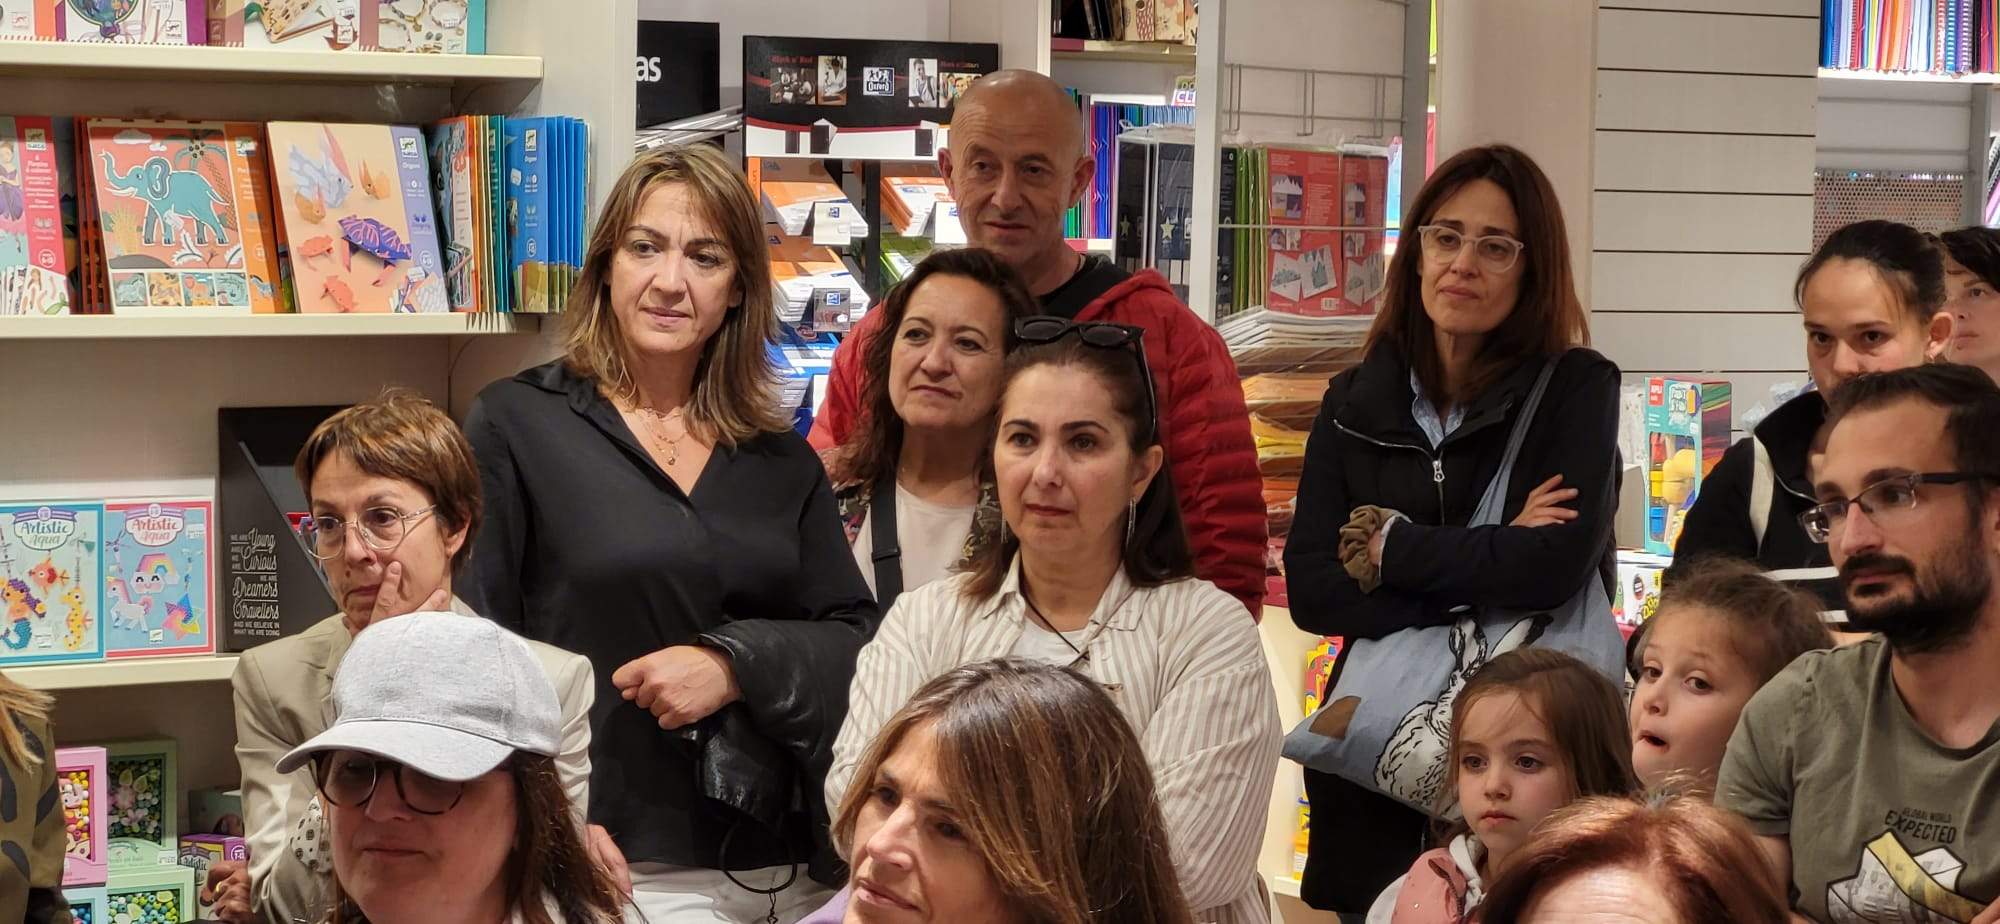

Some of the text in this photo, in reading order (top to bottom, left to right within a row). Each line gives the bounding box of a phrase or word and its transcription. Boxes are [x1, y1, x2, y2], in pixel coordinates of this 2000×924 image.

[867, 82, 890, 92] Oxford
[20, 520, 69, 534] Artistic
[131, 517, 178, 531] Artistic
[247, 527, 275, 554] Young
[240, 545, 277, 571] Curious
[232, 576, 278, 598] Dreamers
[253, 621, 273, 629] BELIEVE
[1902, 807, 1952, 823] GLOBAL WORLD
[1884, 810, 1957, 844] EXPECTED
